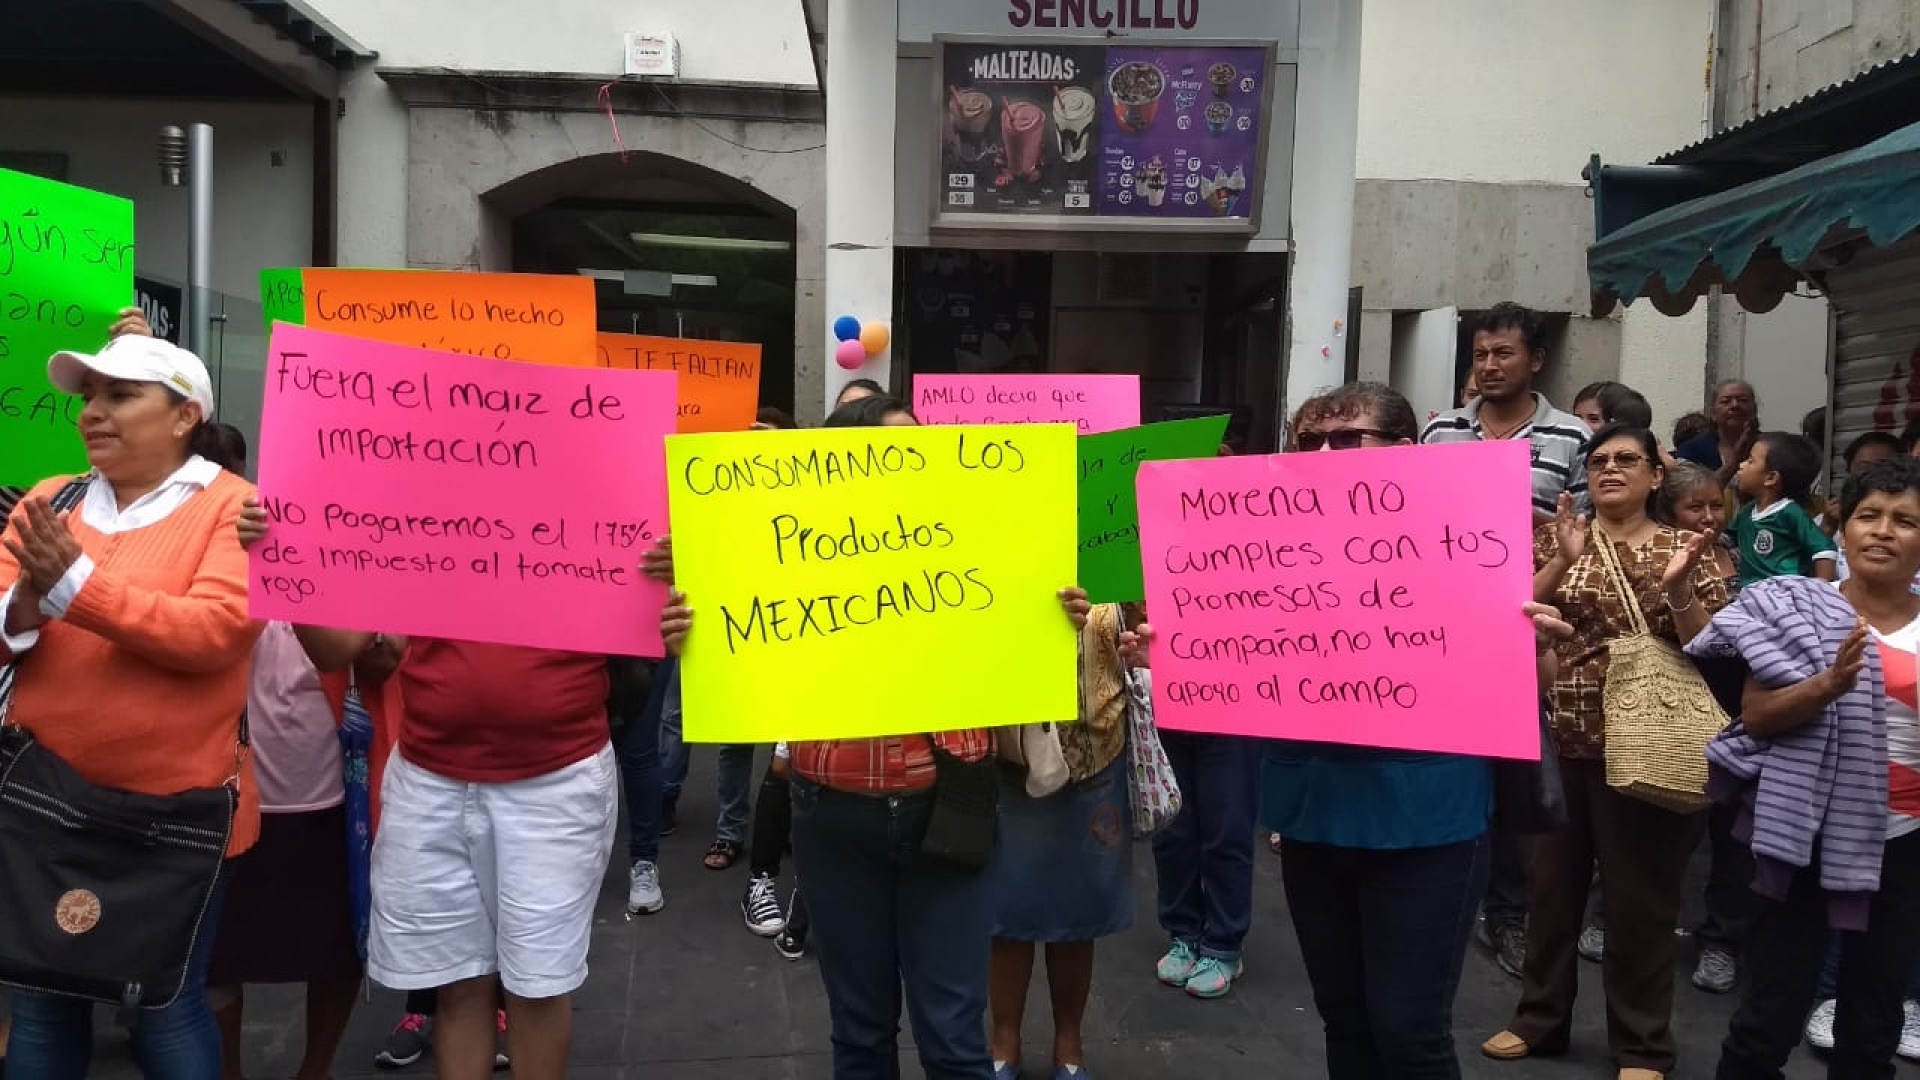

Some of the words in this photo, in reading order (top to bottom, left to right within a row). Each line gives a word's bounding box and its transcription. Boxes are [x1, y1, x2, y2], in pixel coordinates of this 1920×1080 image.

[1008, 0, 1199, 29] SENCILLO
[974, 51, 1075, 81] MALTEADAS
[317, 289, 438, 324] Consume
[450, 297, 475, 321] lo
[485, 299, 565, 327] hecho
[664, 351, 754, 379] FALTAN
[278, 352, 375, 406] Fuera
[387, 371, 432, 412] el
[570, 383, 625, 421] de
[922, 386, 975, 407] AMLO
[1051, 388, 1087, 411] que
[685, 443, 926, 495] CONSUMAMOS
[957, 433, 1024, 473] LOS
[1180, 485, 1324, 522] Morena
[1348, 480, 1405, 515] no
[531, 516, 568, 550] el
[771, 514, 954, 564] Productos
[1440, 524, 1509, 568] tus
[261, 539, 303, 565] de
[471, 551, 498, 579] al
[516, 551, 627, 586] tomate
[720, 568, 994, 655] MEXICANOS
[1359, 578, 1414, 609] de
[1384, 625, 1447, 658] hay
[1257, 675, 1282, 706] al
